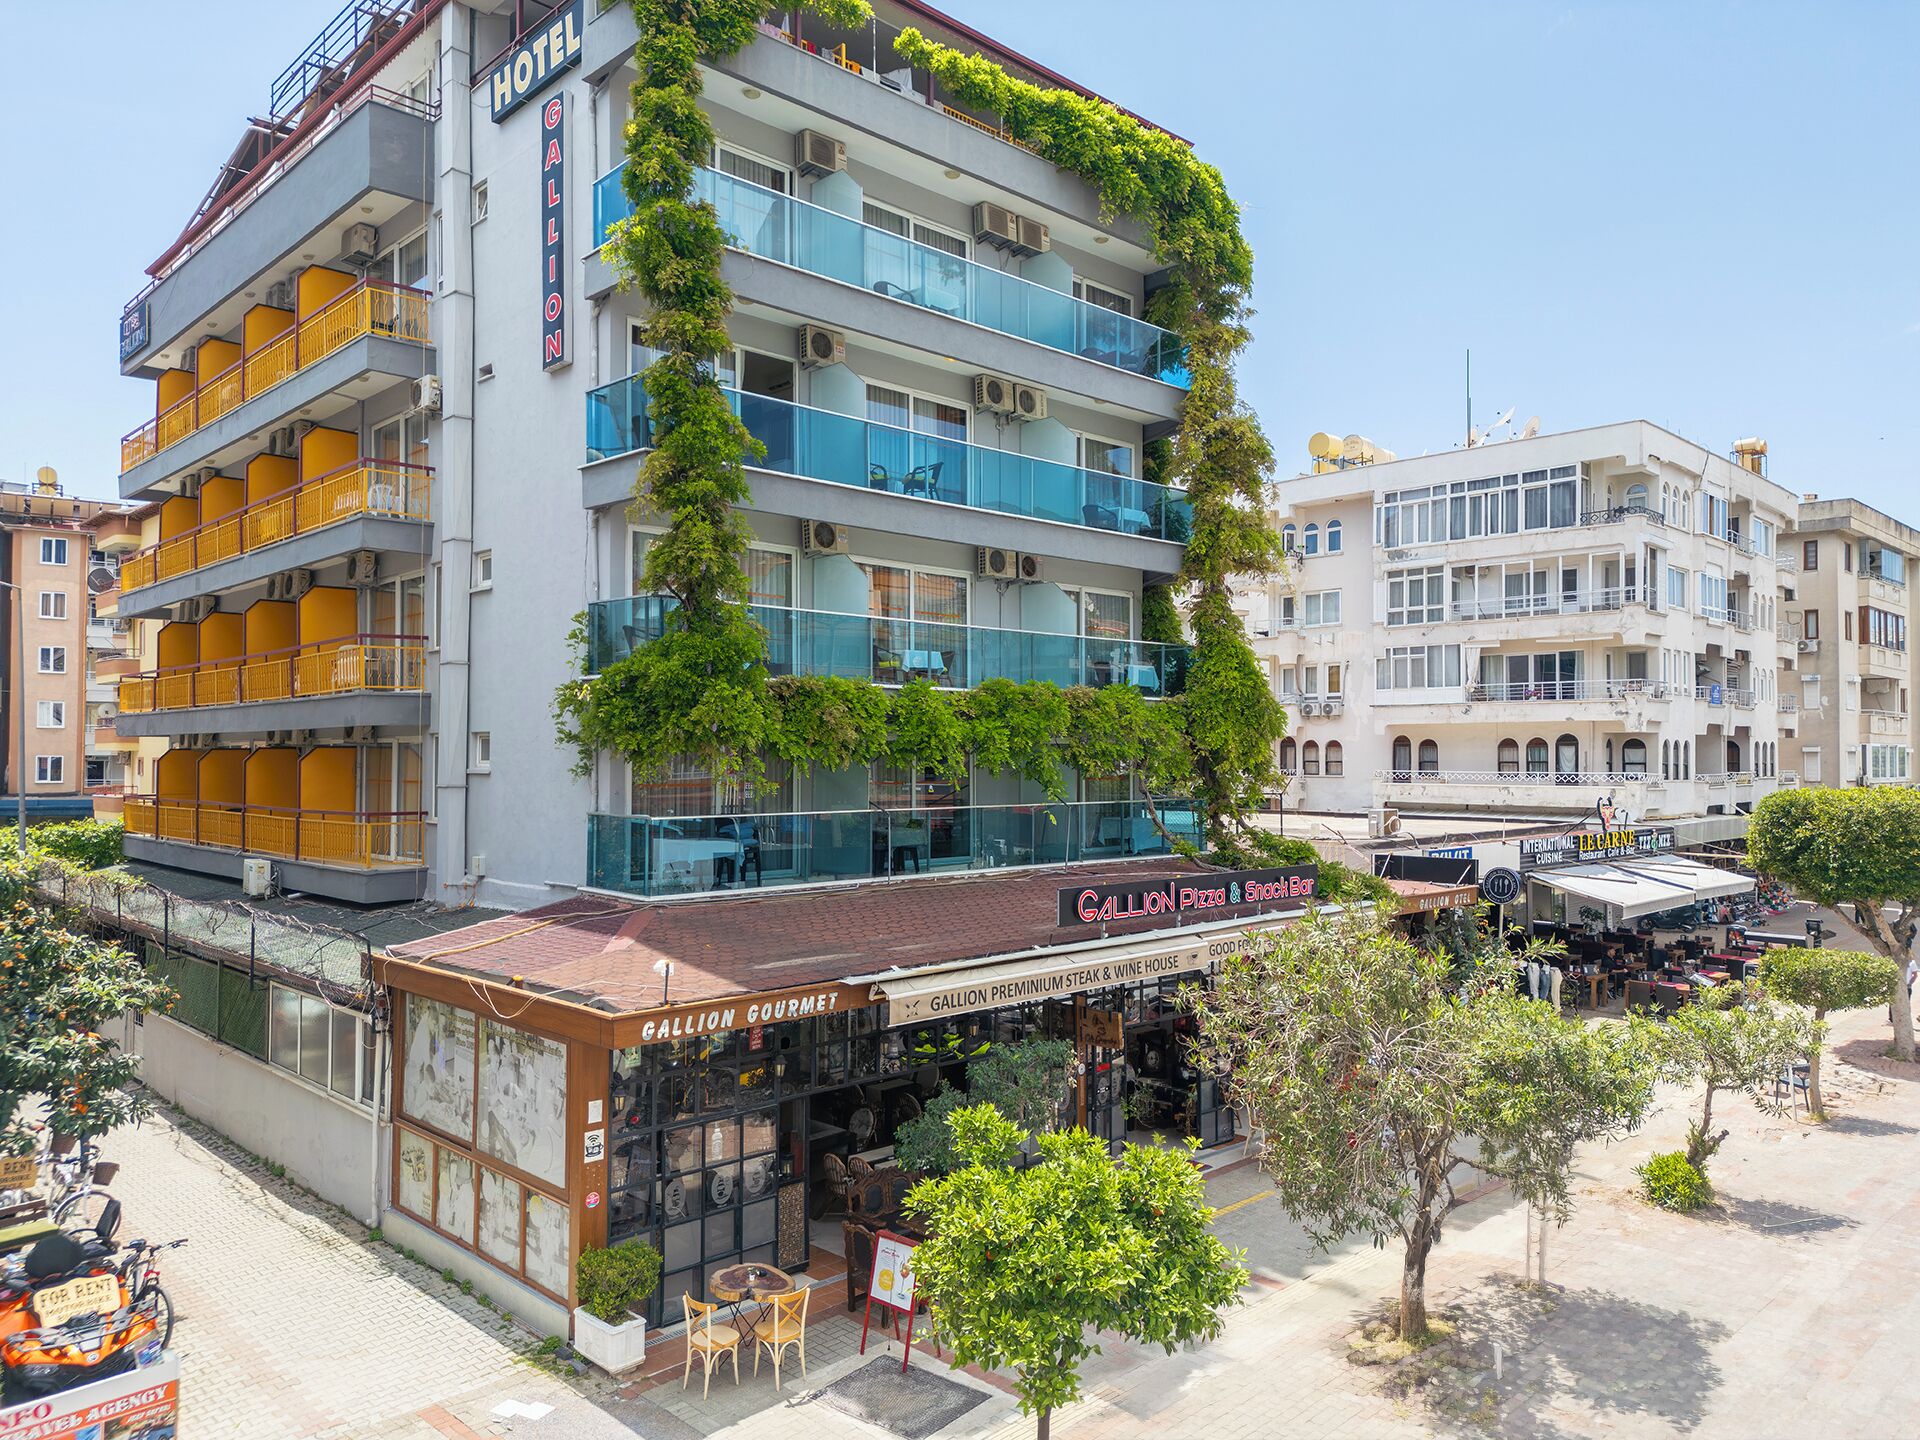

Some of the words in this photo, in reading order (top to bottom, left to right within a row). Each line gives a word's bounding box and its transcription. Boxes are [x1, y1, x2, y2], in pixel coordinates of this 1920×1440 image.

[493, 12, 580, 112] HOTEL
[544, 98, 562, 362] GALLION
[1522, 835, 1575, 853] INTERNATIONAL
[1579, 833, 1594, 851] LE
[1597, 830, 1635, 849] CARNE
[1536, 852, 1562, 864] CUISINE
[1579, 849, 1605, 861] Restaurant
[1078, 881, 1175, 922] GALLION
[1180, 888, 1225, 910] Pizza
[1230, 882, 1241, 903] &
[1245, 876, 1289, 902] Snack
[1290, 876, 1314, 896] Bar
[1420, 895, 1449, 910] GALLION
[1454, 893, 1471, 905] OTEL
[1209, 941, 1235, 956] GOOD
[931, 989, 987, 1011] GALLION
[991, 975, 1063, 1001] PREMINIUM
[1065, 968, 1100, 987] STEAK
[1103, 966, 1112, 980] &
[1114, 961, 1142, 978] WINE
[1145, 955, 1179, 973] HOUSE
[641, 1008, 736, 1041] GALLION
[747, 992, 839, 1023] GOURMET
[40, 1287, 70, 1308] FOR
[75, 1278, 112, 1299] RENT
